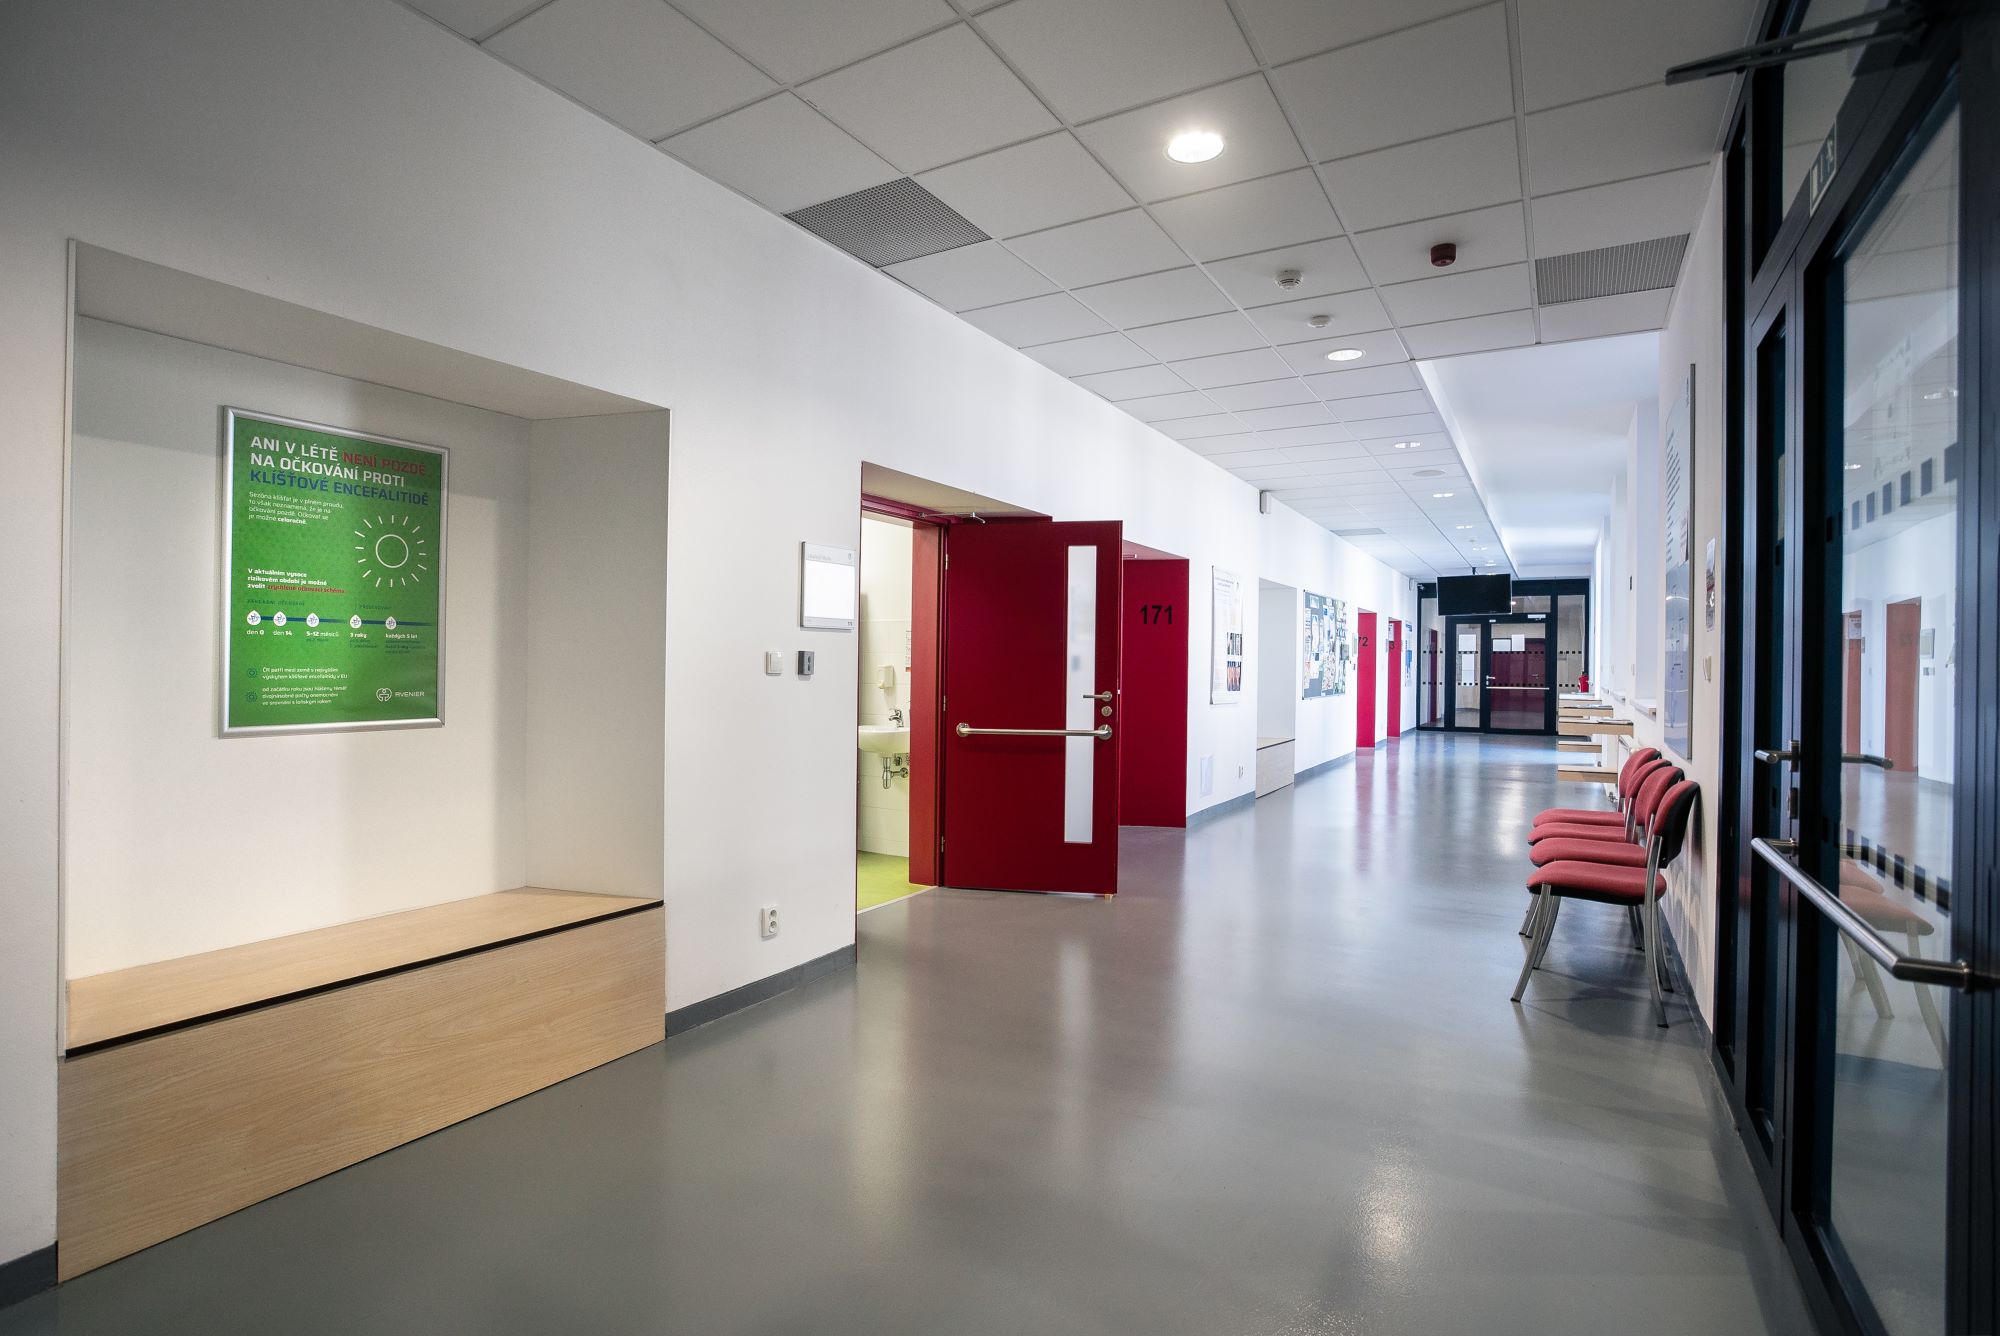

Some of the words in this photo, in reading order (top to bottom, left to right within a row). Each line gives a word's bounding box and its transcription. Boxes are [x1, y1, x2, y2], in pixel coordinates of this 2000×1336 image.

[251, 436, 280, 452] ANI
[285, 441, 296, 454] V
[301, 443, 338, 461] LÉTĚ
[342, 451, 377, 469] NENÍ
[251, 453, 275, 468] NA
[280, 456, 359, 480] OČKOVÁNÍ
[363, 470, 405, 487] PROTI
[249, 470, 329, 492] KLÍŠŤOVÉ
[333, 481, 429, 506] ENCEFALITIDĚ
[1139, 604, 1173, 625] 171
